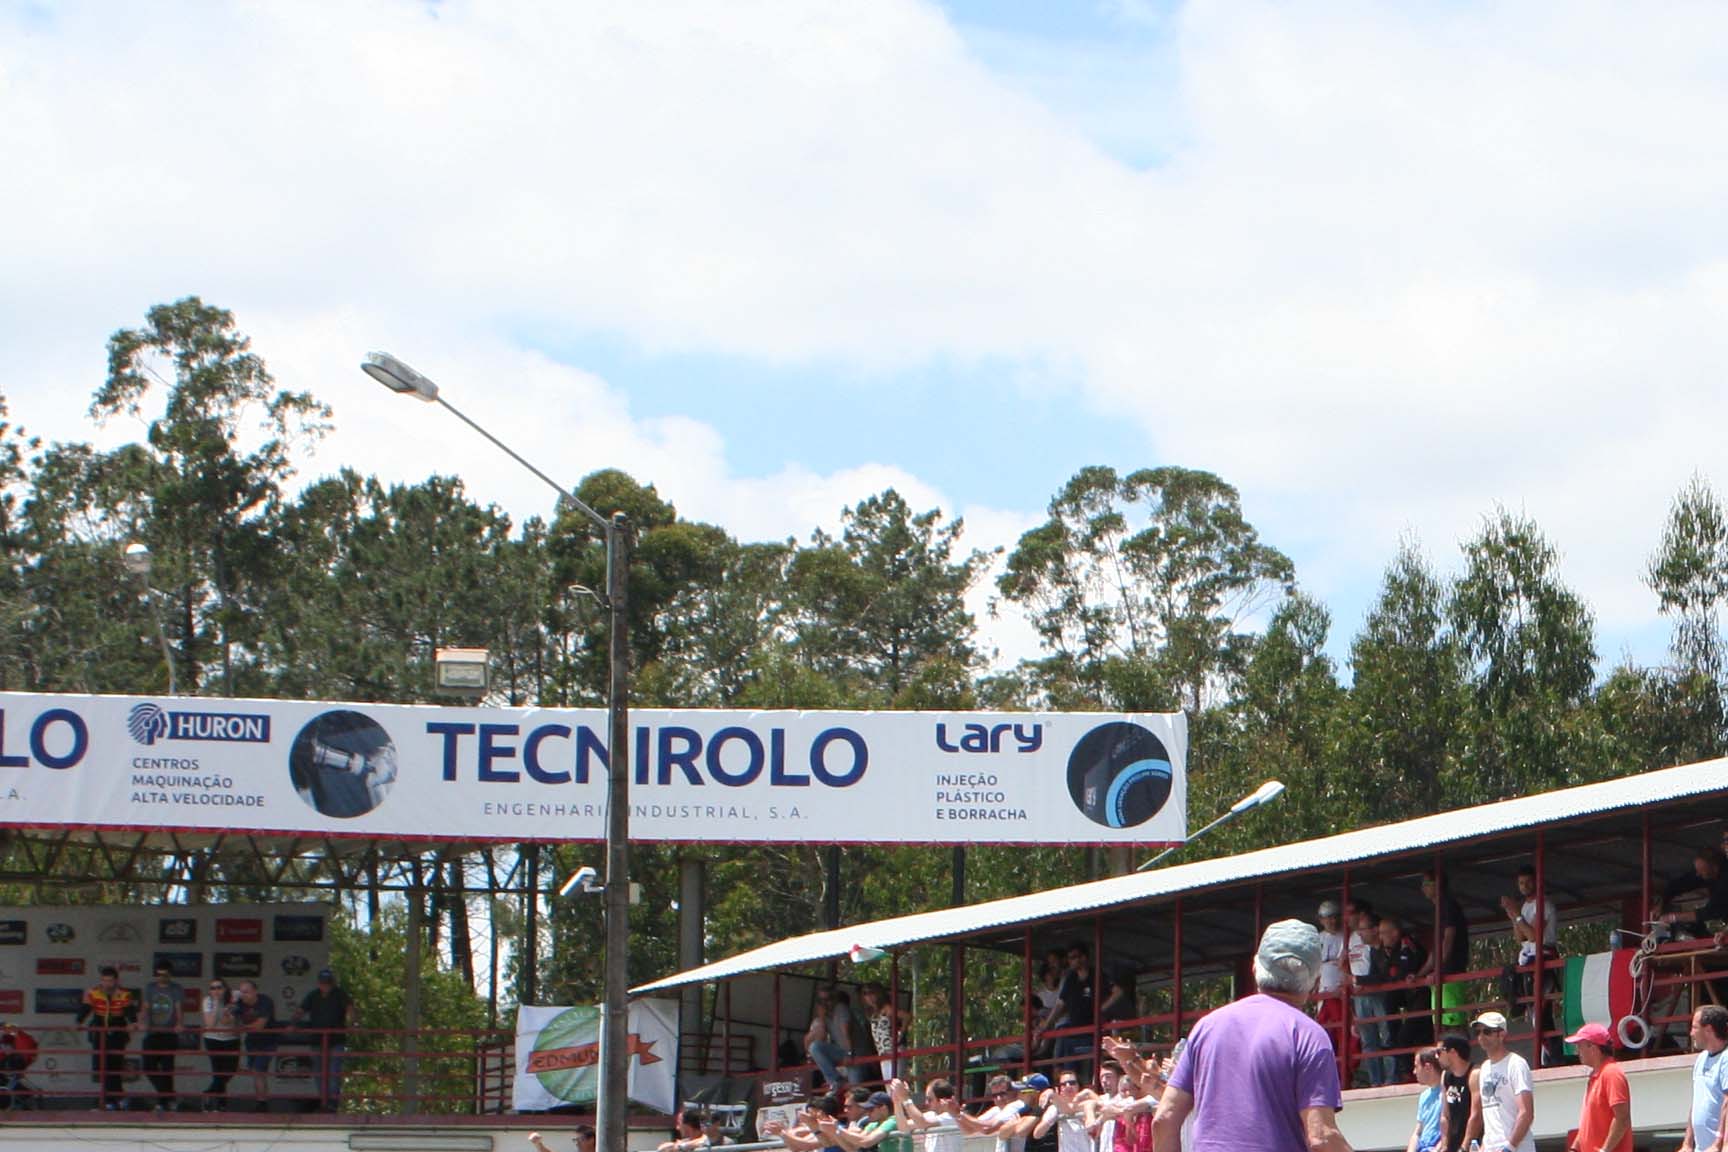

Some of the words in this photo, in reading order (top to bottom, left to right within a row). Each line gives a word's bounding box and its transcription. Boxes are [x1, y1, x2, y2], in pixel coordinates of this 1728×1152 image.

[178, 714, 263, 740] HURON
[426, 721, 869, 788] TECNIROLO
[132, 757, 200, 771] CENTROS
[132, 774, 233, 790] MAQUINAÇÃO
[936, 773, 998, 788] INJEÇÃO
[131, 791, 169, 805] ALTA
[173, 793, 265, 807] VELOCIDADE
[936, 789, 1006, 804] PLÁSTICO
[484, 802, 609, 817] ENGENHARI
[769, 806, 809, 819] S.A.
[936, 808, 945, 820] E
[949, 808, 1028, 820] BORRACHA
